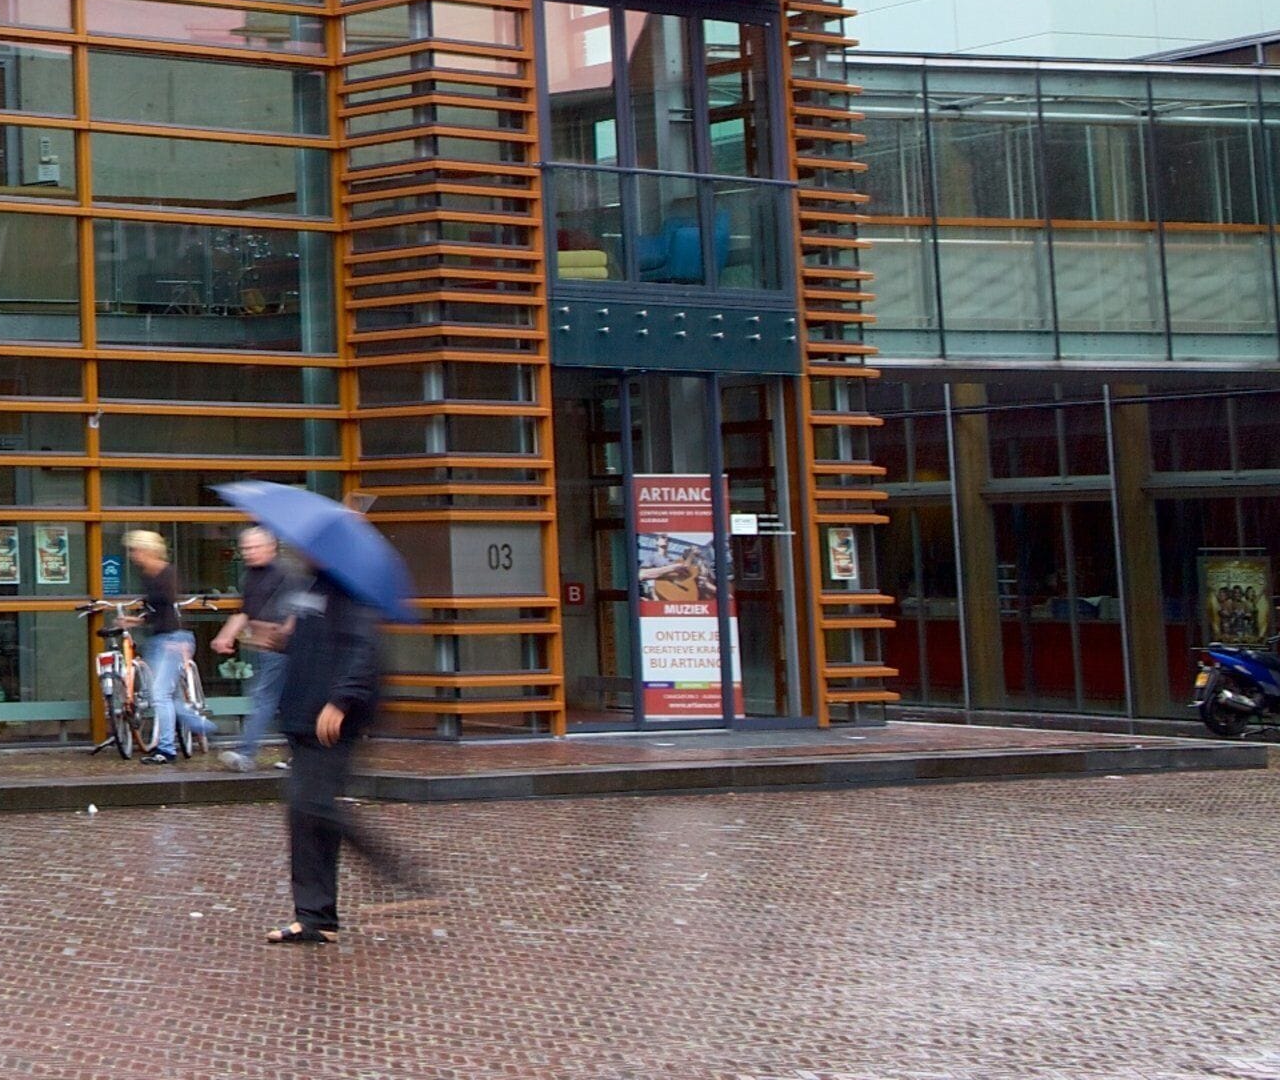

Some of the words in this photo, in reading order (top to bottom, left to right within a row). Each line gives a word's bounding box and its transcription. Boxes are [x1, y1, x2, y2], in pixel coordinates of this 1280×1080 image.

[640, 487, 712, 502] ARTIANC
[487, 543, 514, 571] 03
[568, 585, 582, 602] B
[663, 603, 710, 615] MUZIEK
[655, 630, 706, 642] ONTDEK
